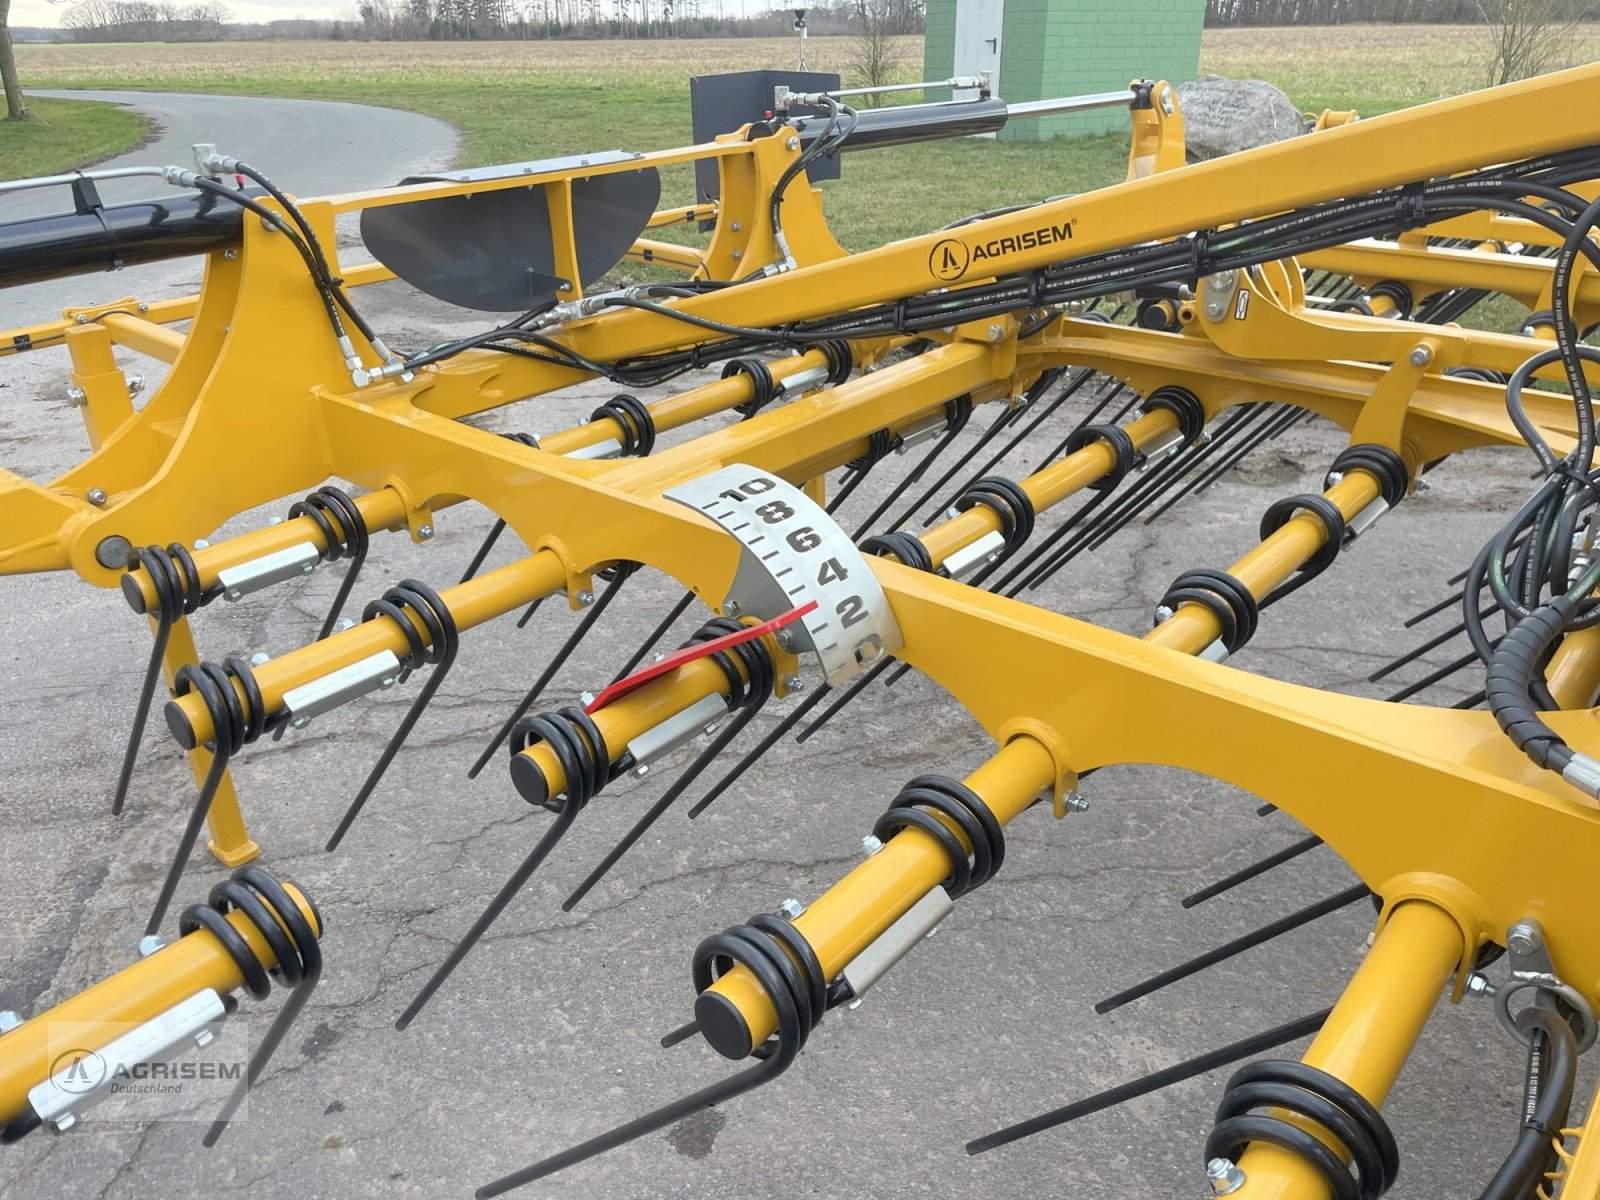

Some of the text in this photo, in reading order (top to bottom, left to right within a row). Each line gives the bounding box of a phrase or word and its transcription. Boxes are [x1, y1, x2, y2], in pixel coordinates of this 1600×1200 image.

[719, 477, 777, 502] 10
[755, 500, 795, 524] 8
[785, 526, 822, 553] 6
[817, 556, 849, 586] 4
[836, 594, 869, 629] 2
[854, 633, 884, 666] 0
